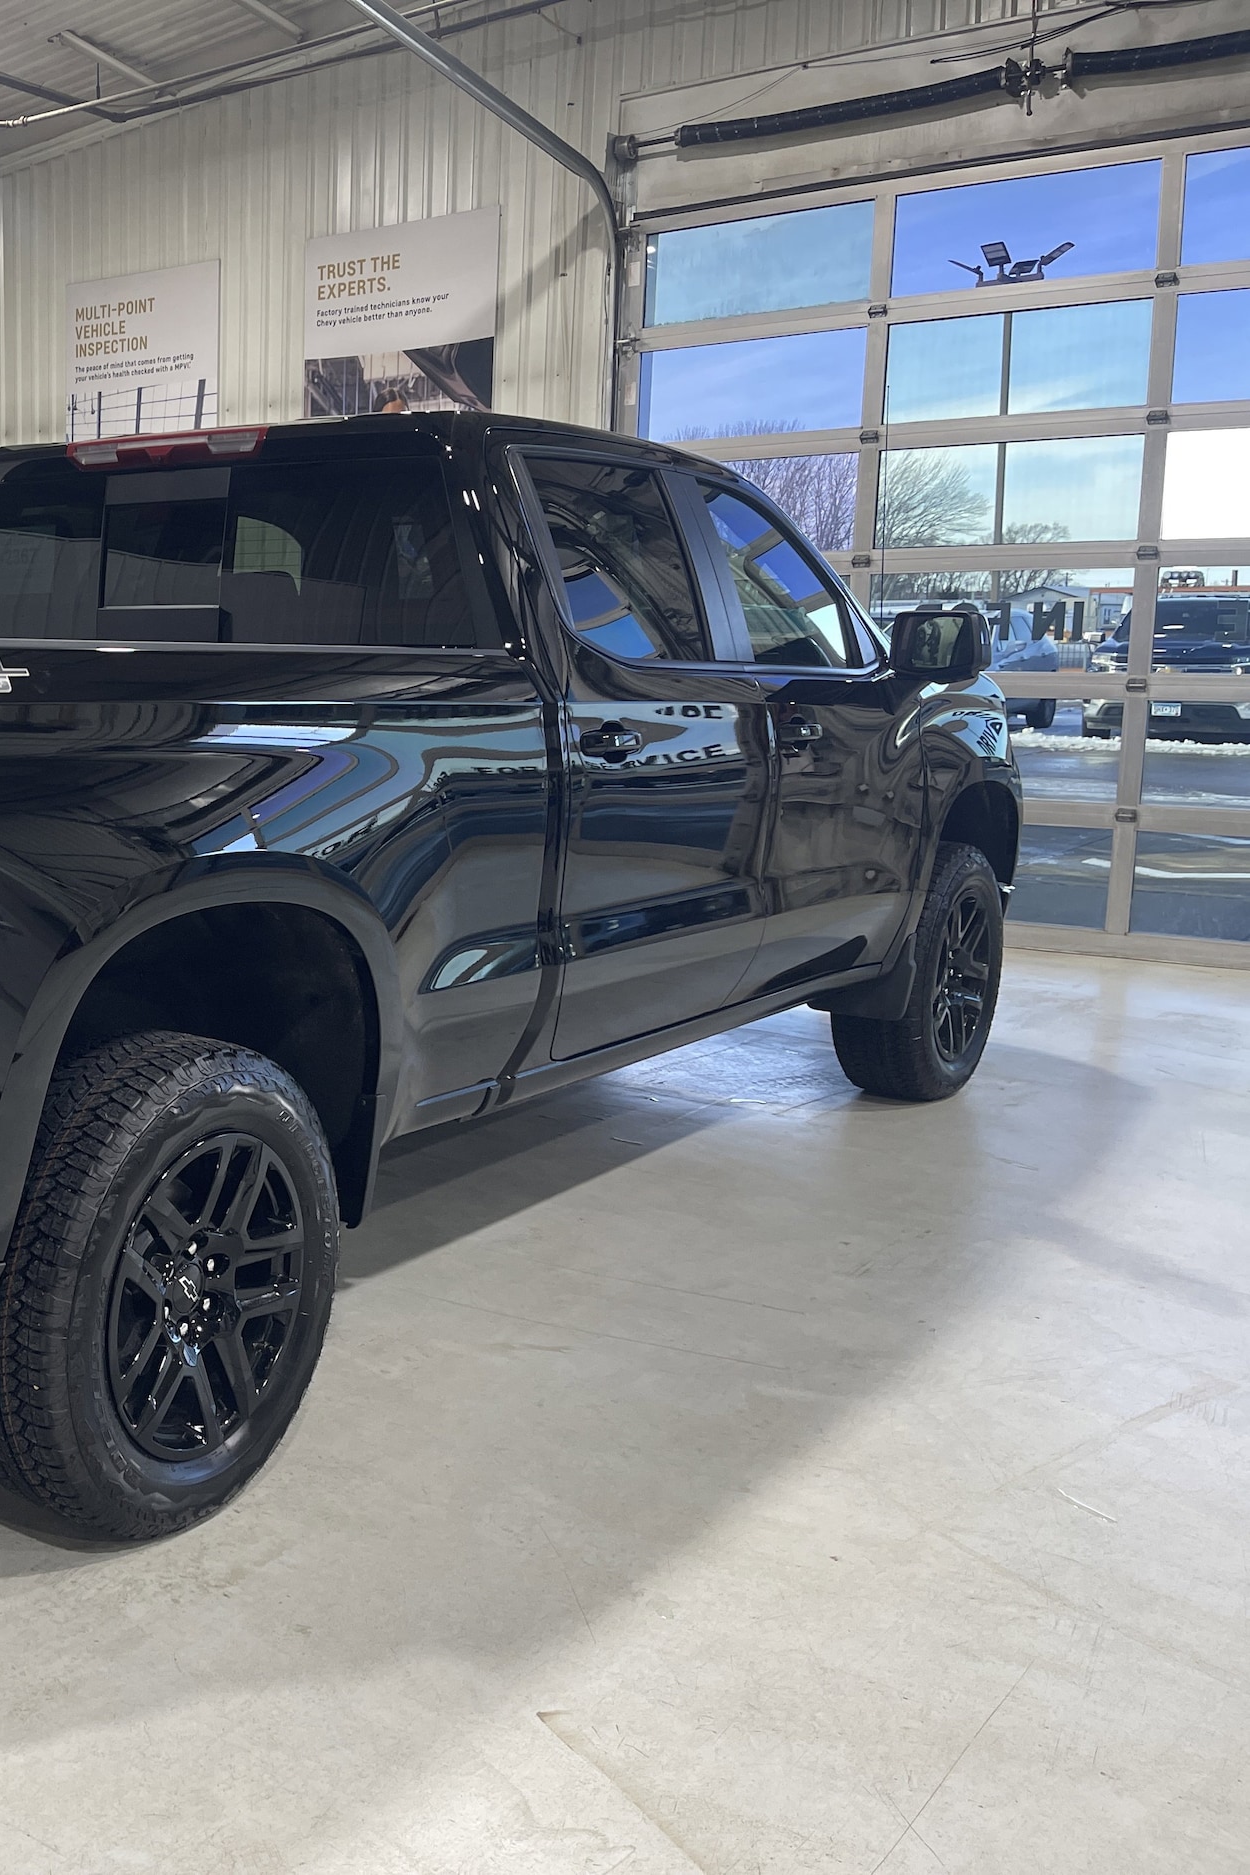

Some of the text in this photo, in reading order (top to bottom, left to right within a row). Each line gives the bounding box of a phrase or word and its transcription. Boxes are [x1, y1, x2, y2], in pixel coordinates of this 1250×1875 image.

[318, 253, 401, 280] TRUST THE
[318, 276, 391, 300] EXPERTS.
[75, 298, 155, 322] MULTI-POINT
[317, 292, 450, 317] Factory trained technicians know your
[316, 307, 432, 328] Chevy vehicle better than anyone.
[75, 320, 126, 340] VEHICLE
[75, 336, 148, 358] INSPECTION
[86, 364, 102, 374] peace
[110, 361, 123, 369] mind
[125, 360, 136, 368] that
[157, 355, 171, 363] from
[172, 353, 194, 364] getting
[75, 376, 87, 384] your
[88, 372, 111, 380] vehicle's
[113, 370, 129, 378] health
[131, 367, 154, 376] checked
